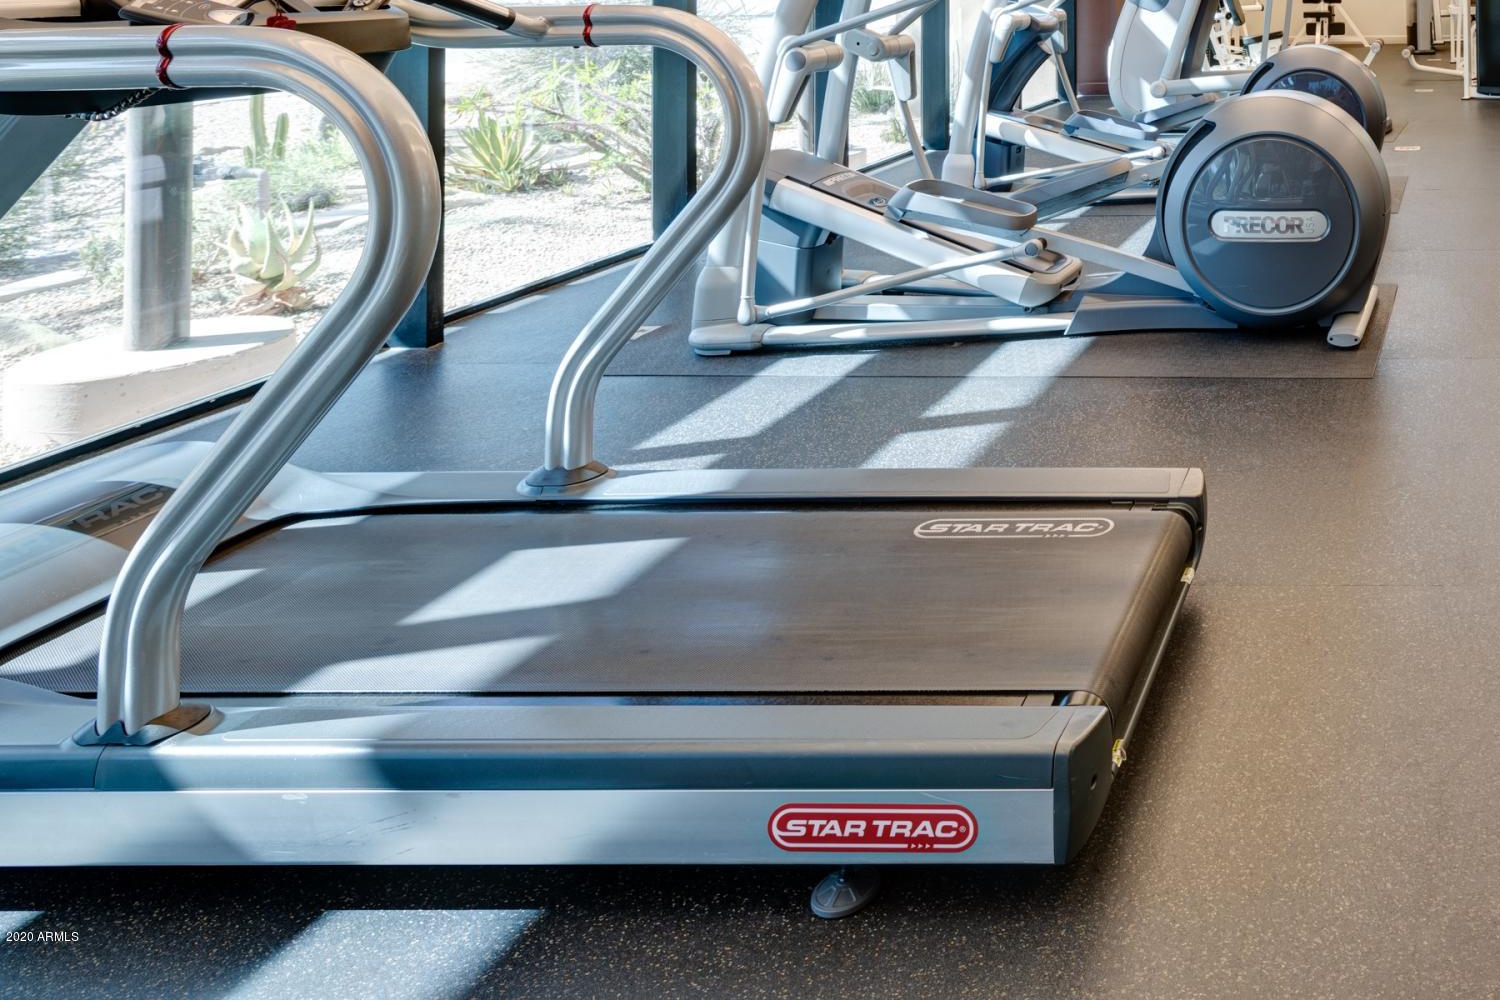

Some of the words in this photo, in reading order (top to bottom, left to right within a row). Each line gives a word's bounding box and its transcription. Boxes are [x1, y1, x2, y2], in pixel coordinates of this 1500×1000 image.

[1223, 215, 1305, 234] PRECOR
[74, 486, 165, 529] RAC
[928, 523, 1009, 533] STAR
[1015, 523, 1099, 533] TRAC
[785, 819, 867, 837] STAR
[872, 820, 958, 838] TRAC
